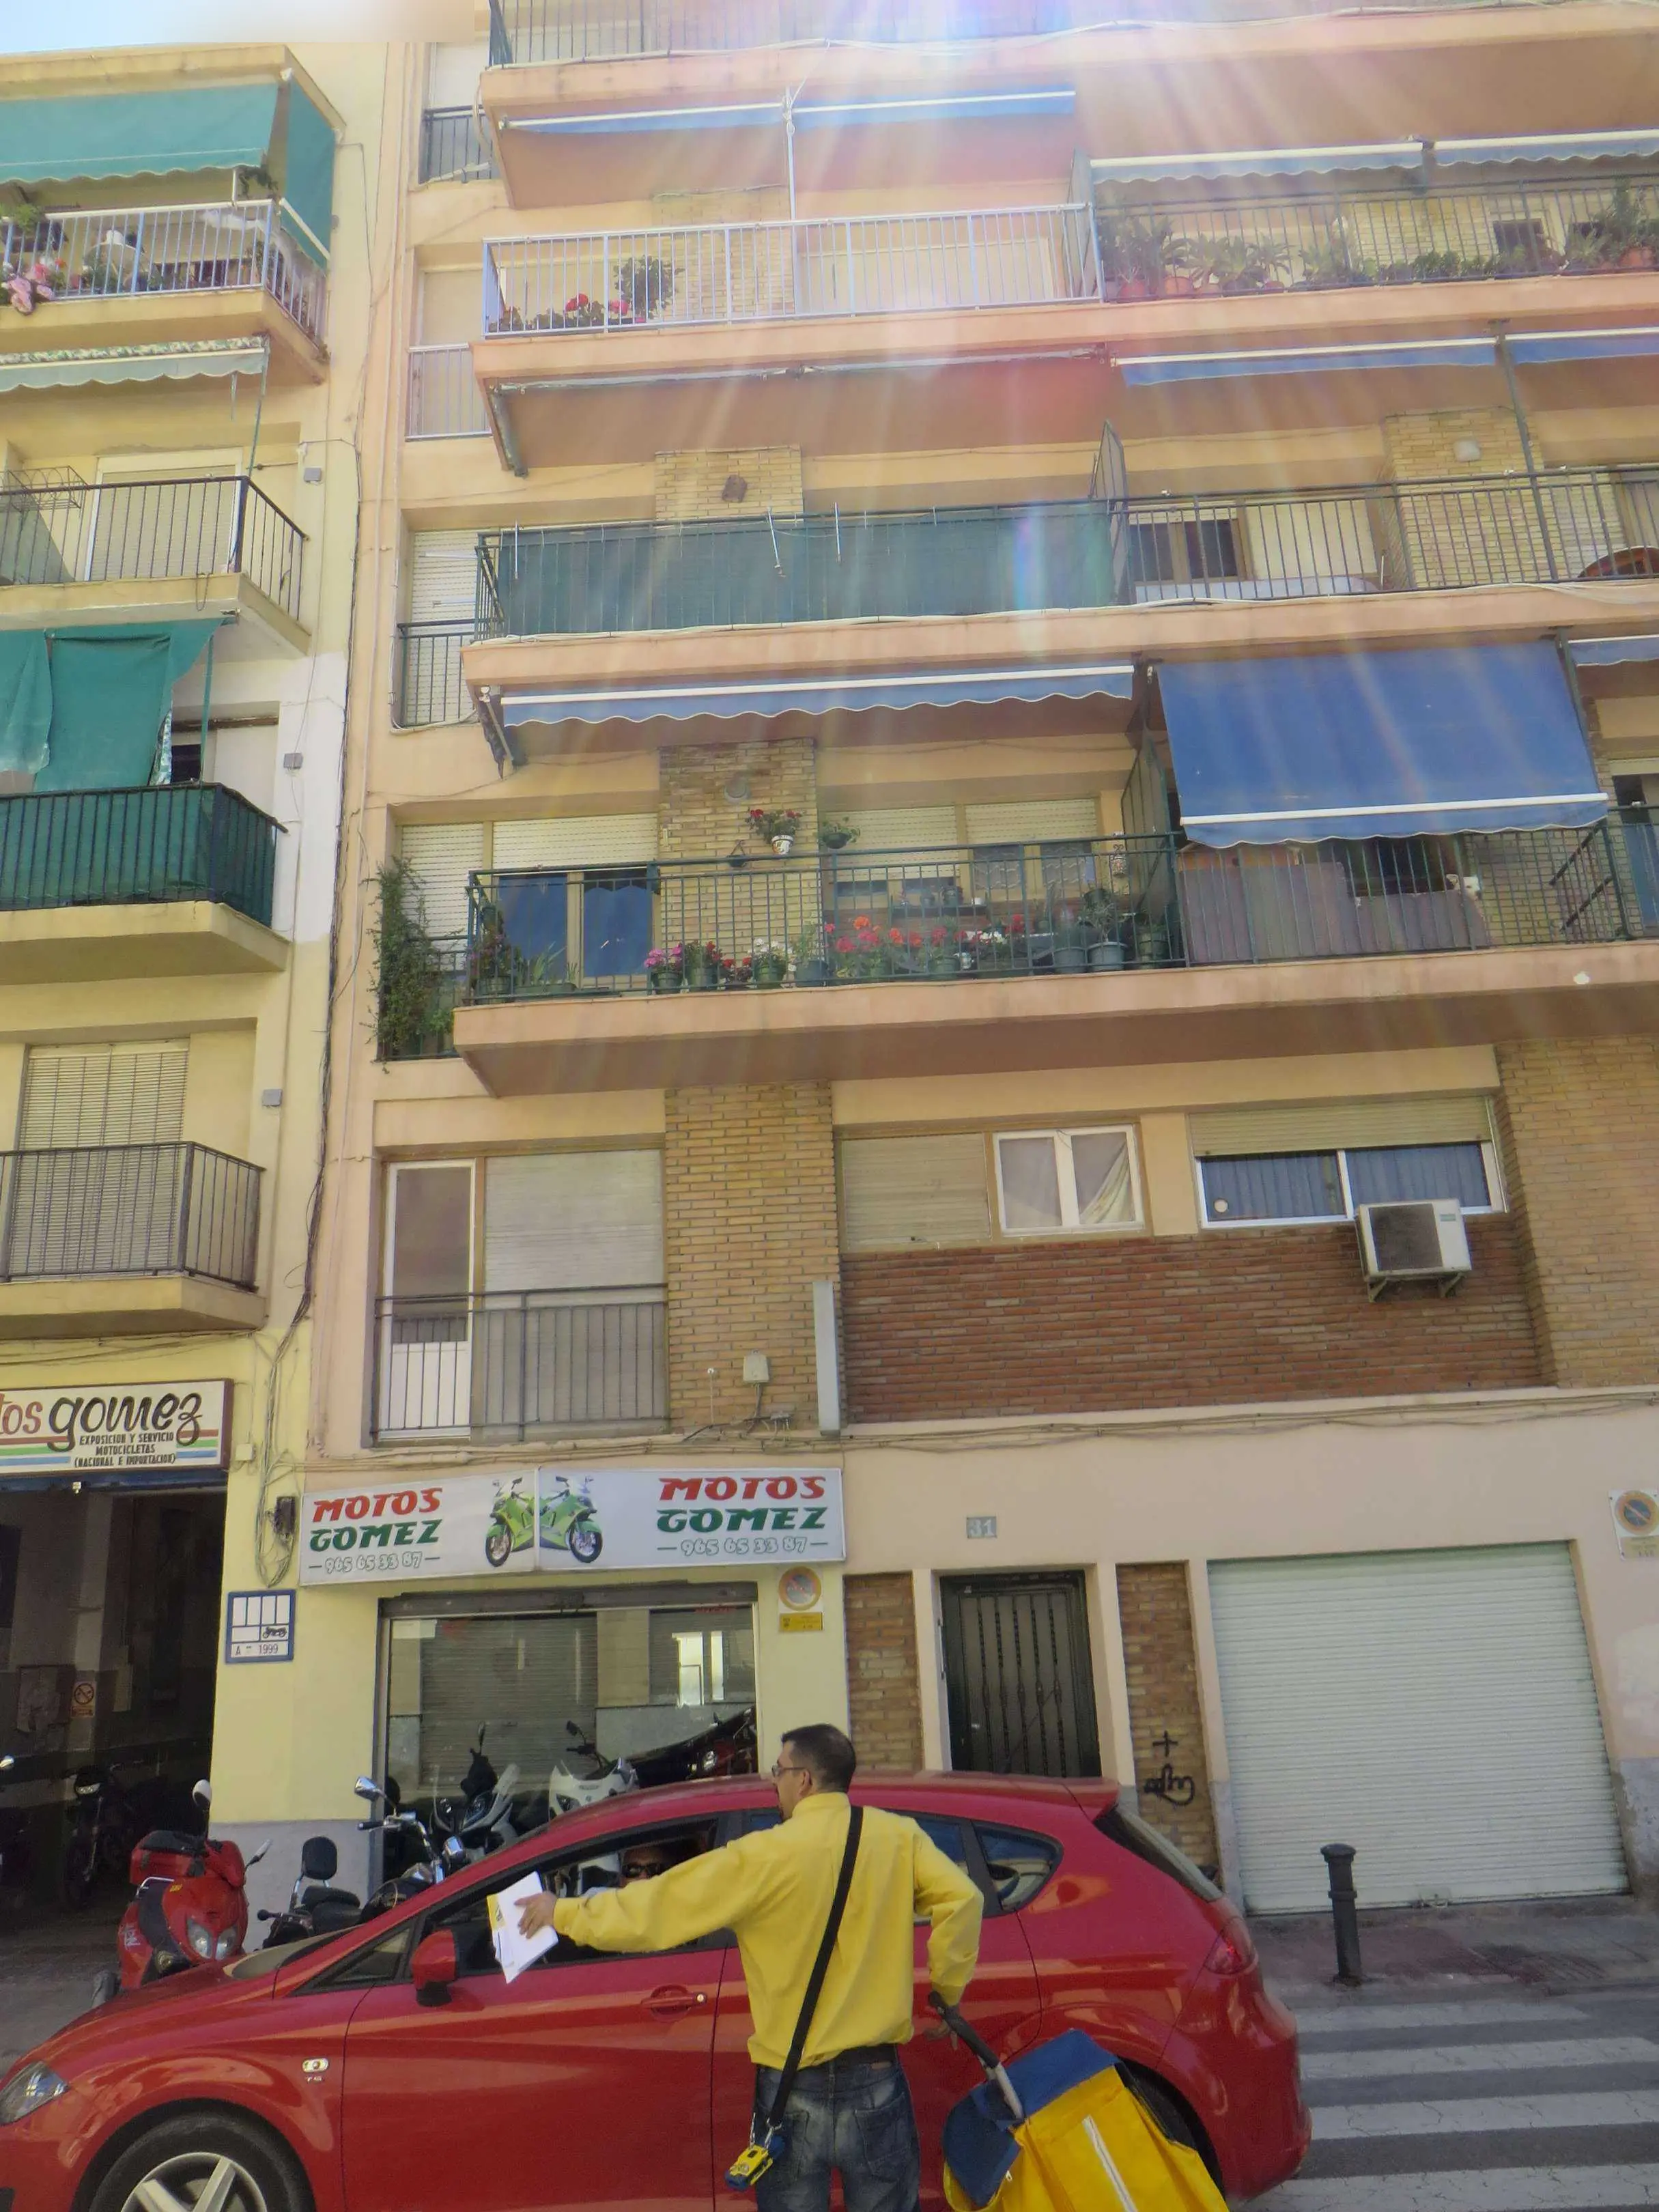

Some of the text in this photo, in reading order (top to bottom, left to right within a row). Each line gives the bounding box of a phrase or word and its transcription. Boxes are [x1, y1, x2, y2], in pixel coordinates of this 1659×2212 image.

[47, 1393, 203, 1452] gomez
[79, 1432, 175, 1445] EXPOSICION Y SERVICIO
[96, 1445, 156, 1456] MOTOCICLETAS
[119, 1456, 123, 1465] E
[659, 1476, 827, 1501] MOTOS
[313, 1488, 443, 1522] MOTOS
[656, 1507, 828, 1533] GOMEZ
[970, 1518, 995, 1537] 31
[310, 1518, 443, 1552] GOMEZ
[681, 1537, 807, 1556] 965 65 33 87
[325, 1557, 353, 1574] 965
[356, 1555, 375, 1572] 65
[378, 1553, 399, 1570] 33
